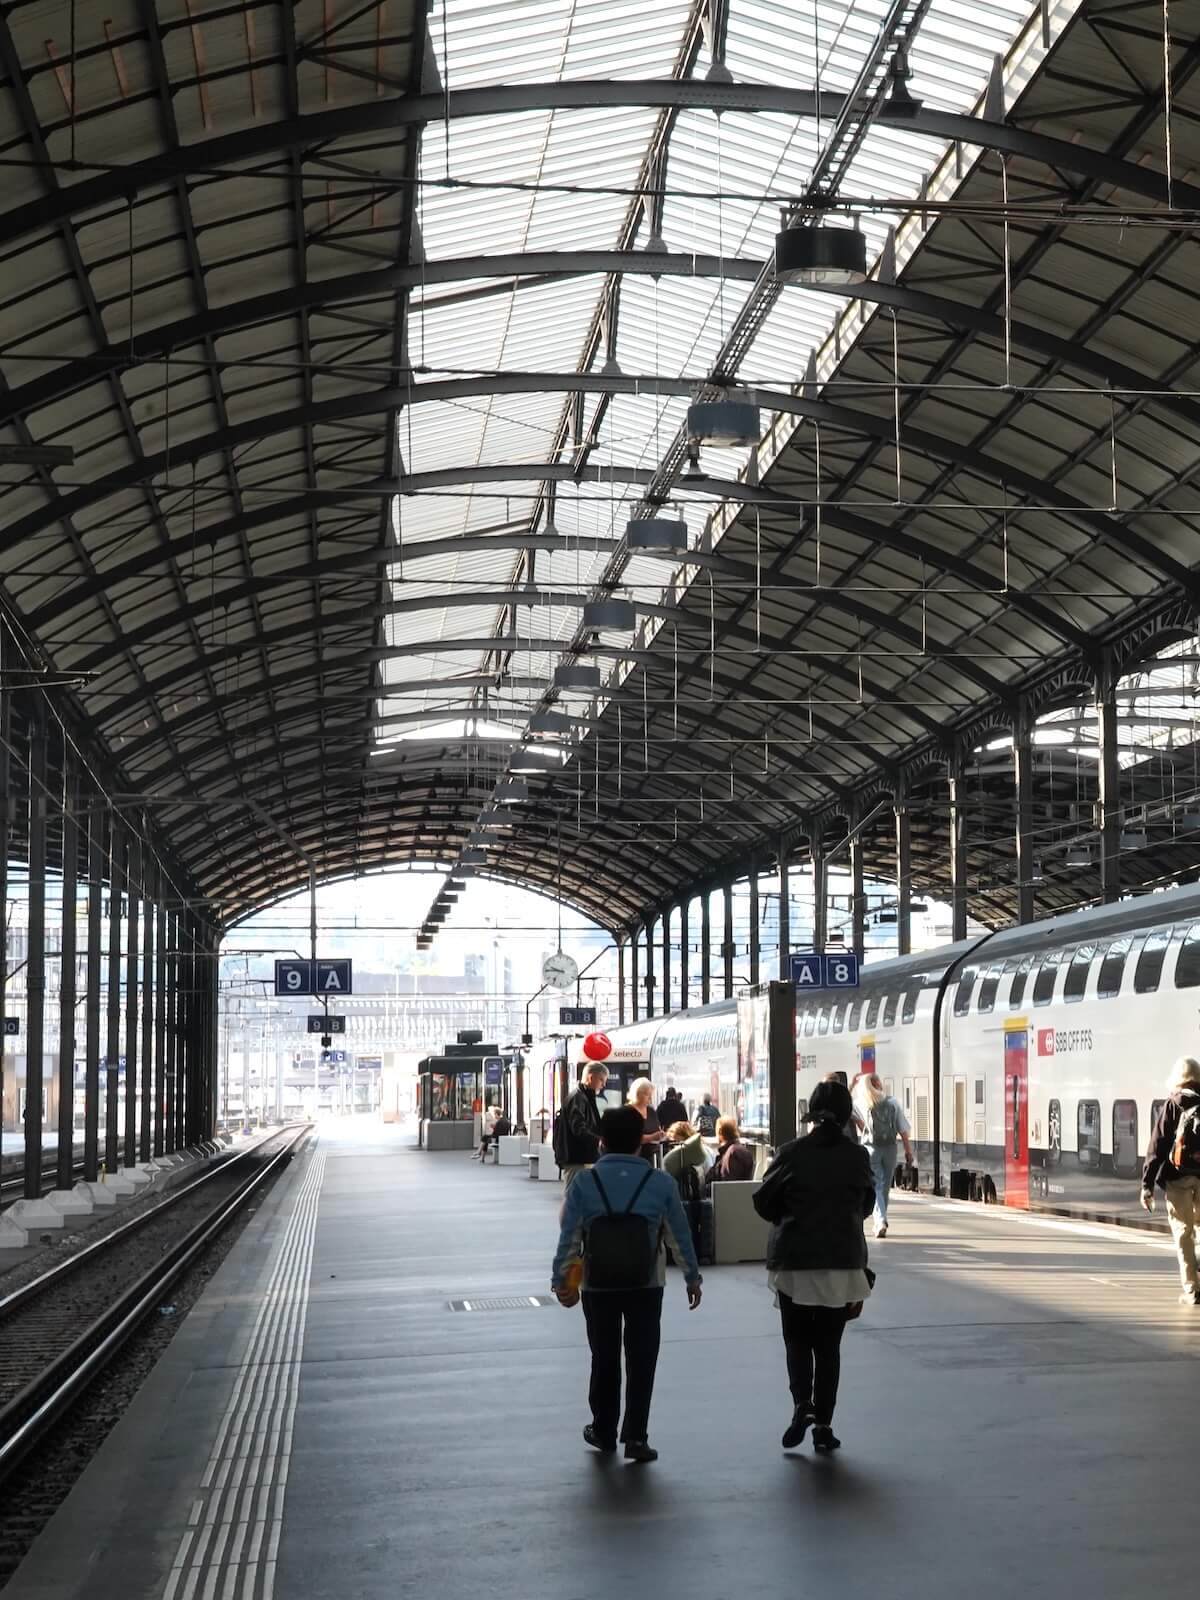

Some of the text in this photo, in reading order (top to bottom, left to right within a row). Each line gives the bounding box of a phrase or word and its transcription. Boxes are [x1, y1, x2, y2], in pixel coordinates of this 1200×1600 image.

[286, 970, 341, 990] 9 A
[798, 963, 849, 983] A 8
[564, 1012, 591, 1022] B 8
[313, 1021, 340, 1031] 9 B
[1055, 1028, 1093, 1052] SBB CFF FFS
[613, 1050, 642, 1058] selecta
